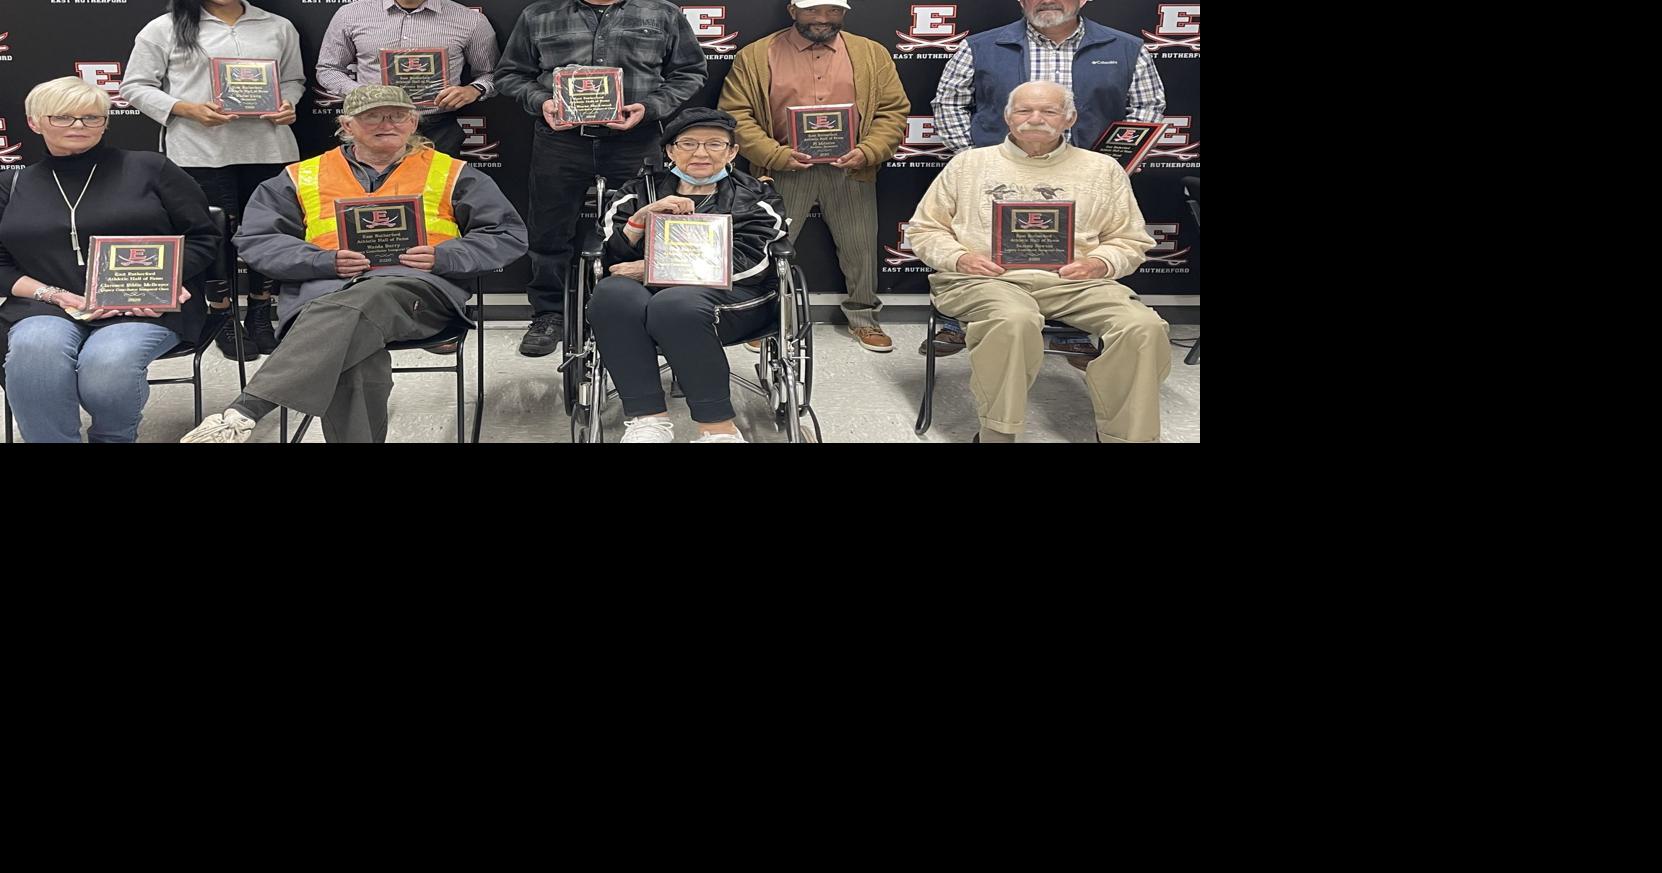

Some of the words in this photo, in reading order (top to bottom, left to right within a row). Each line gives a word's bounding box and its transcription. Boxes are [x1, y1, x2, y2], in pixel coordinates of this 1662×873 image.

[681, 5, 726, 38] E
[910, 4, 957, 37] E
[1156, 3, 1200, 36] E
[75, 61, 122, 93] E
[903, 115, 945, 146] E
